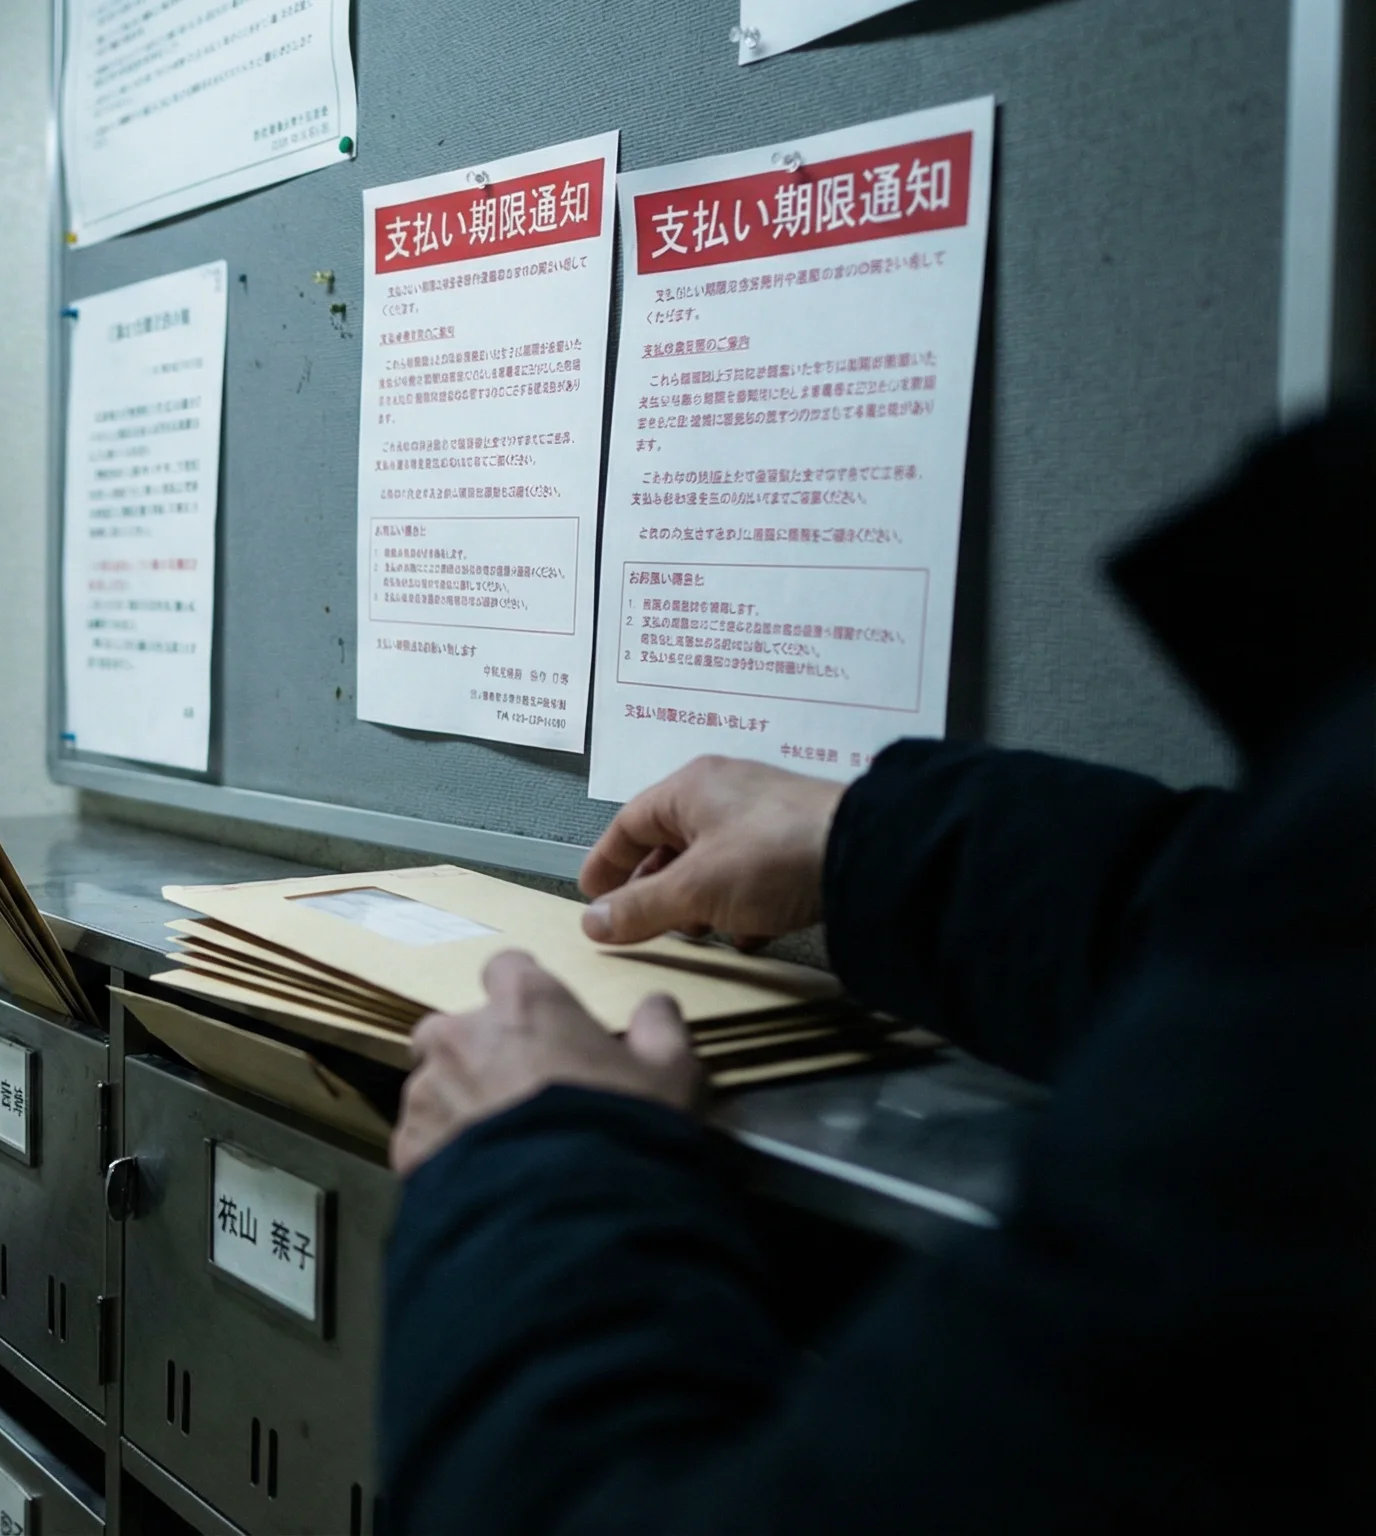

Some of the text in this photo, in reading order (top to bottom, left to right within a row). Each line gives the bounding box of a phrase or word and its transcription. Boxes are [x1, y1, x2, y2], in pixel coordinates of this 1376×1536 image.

[384, 180, 590, 262] 支払い期限通知
[651, 159, 951, 259] 支払い期限通知
